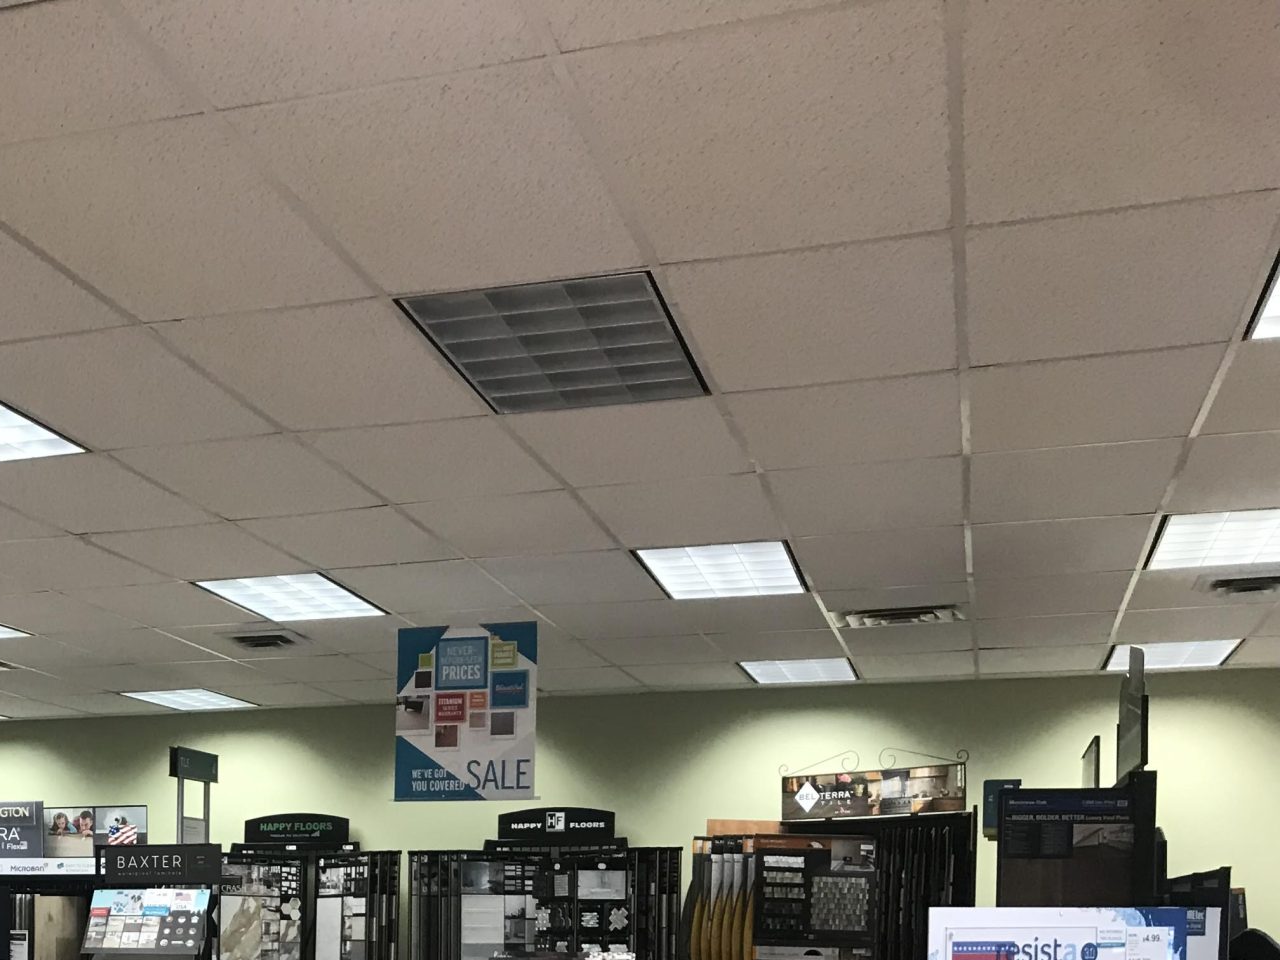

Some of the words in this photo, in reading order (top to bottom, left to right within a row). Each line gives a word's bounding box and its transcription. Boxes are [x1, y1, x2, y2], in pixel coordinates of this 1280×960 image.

[442, 664, 481, 680] PRICES
[412, 769, 433, 779] WE'VE
[466, 759, 531, 790] SALE
[412, 780, 428, 791] YOU
[429, 780, 465, 791] COVERED
[820, 791, 851, 800] TERRA
[260, 822, 292, 831] HAPPY
[294, 822, 333, 831] FLOORS
[117, 855, 182, 869] BAXTER
